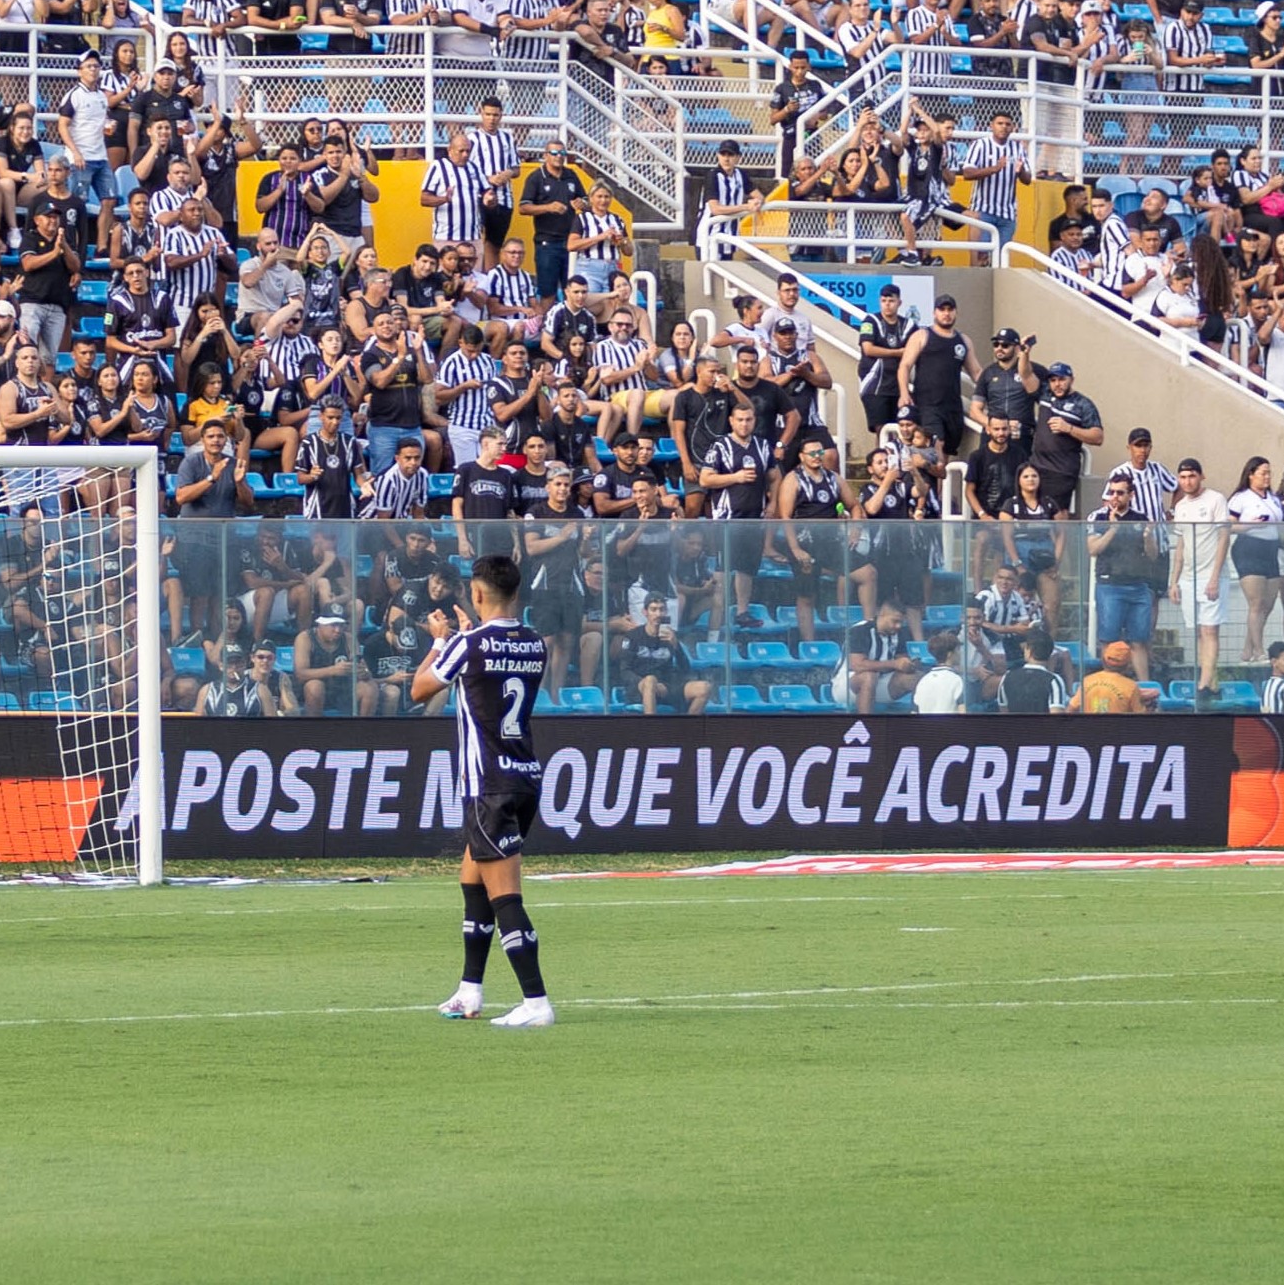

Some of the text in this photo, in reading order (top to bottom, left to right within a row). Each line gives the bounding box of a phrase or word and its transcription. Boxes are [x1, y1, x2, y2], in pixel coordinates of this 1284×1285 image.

[808, 281, 867, 298] ESSO
[490, 636, 544, 654] brisanet
[484, 658, 543, 673] RAÍ RAMOS
[501, 677, 526, 740] 2
[539, 747, 681, 839] QUE
[696, 720, 872, 826] VOCÊ
[874, 744, 1187, 824] ACREDITA
